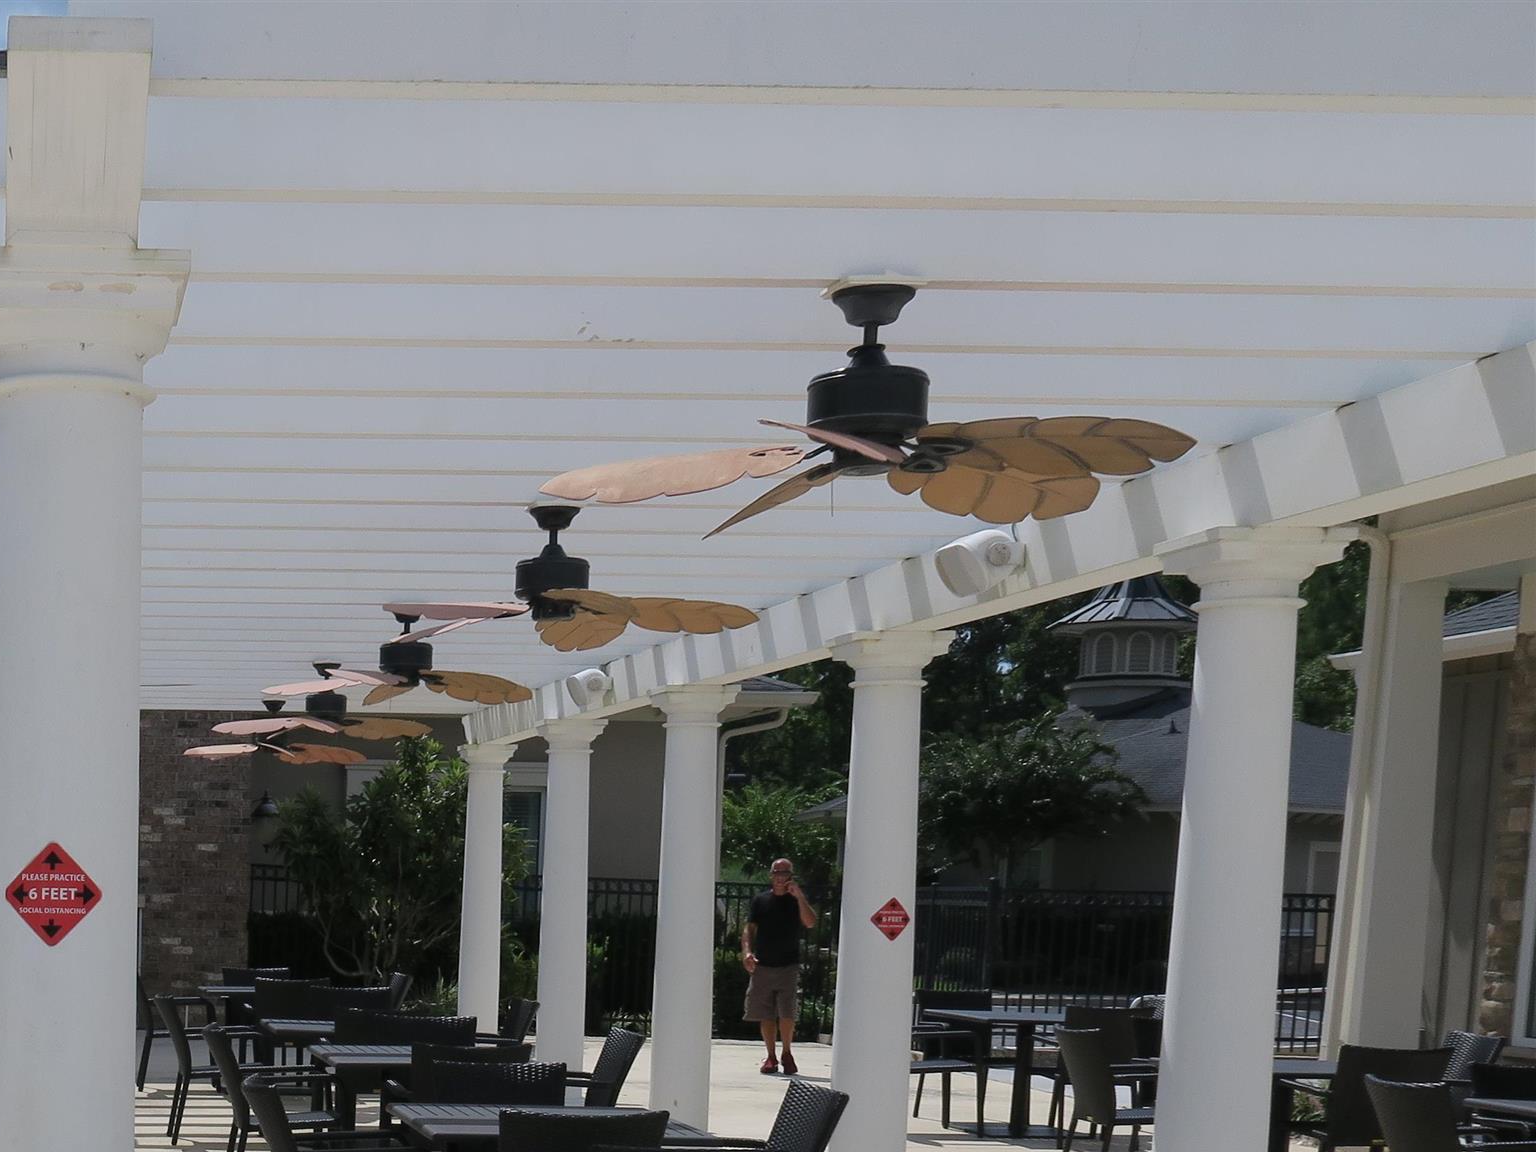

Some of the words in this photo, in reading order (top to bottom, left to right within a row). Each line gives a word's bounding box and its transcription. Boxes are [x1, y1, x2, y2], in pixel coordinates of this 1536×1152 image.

[50, 874, 85, 882] PRACTICE
[29, 888, 37, 900] 6
[41, 888, 77, 900] FEET
